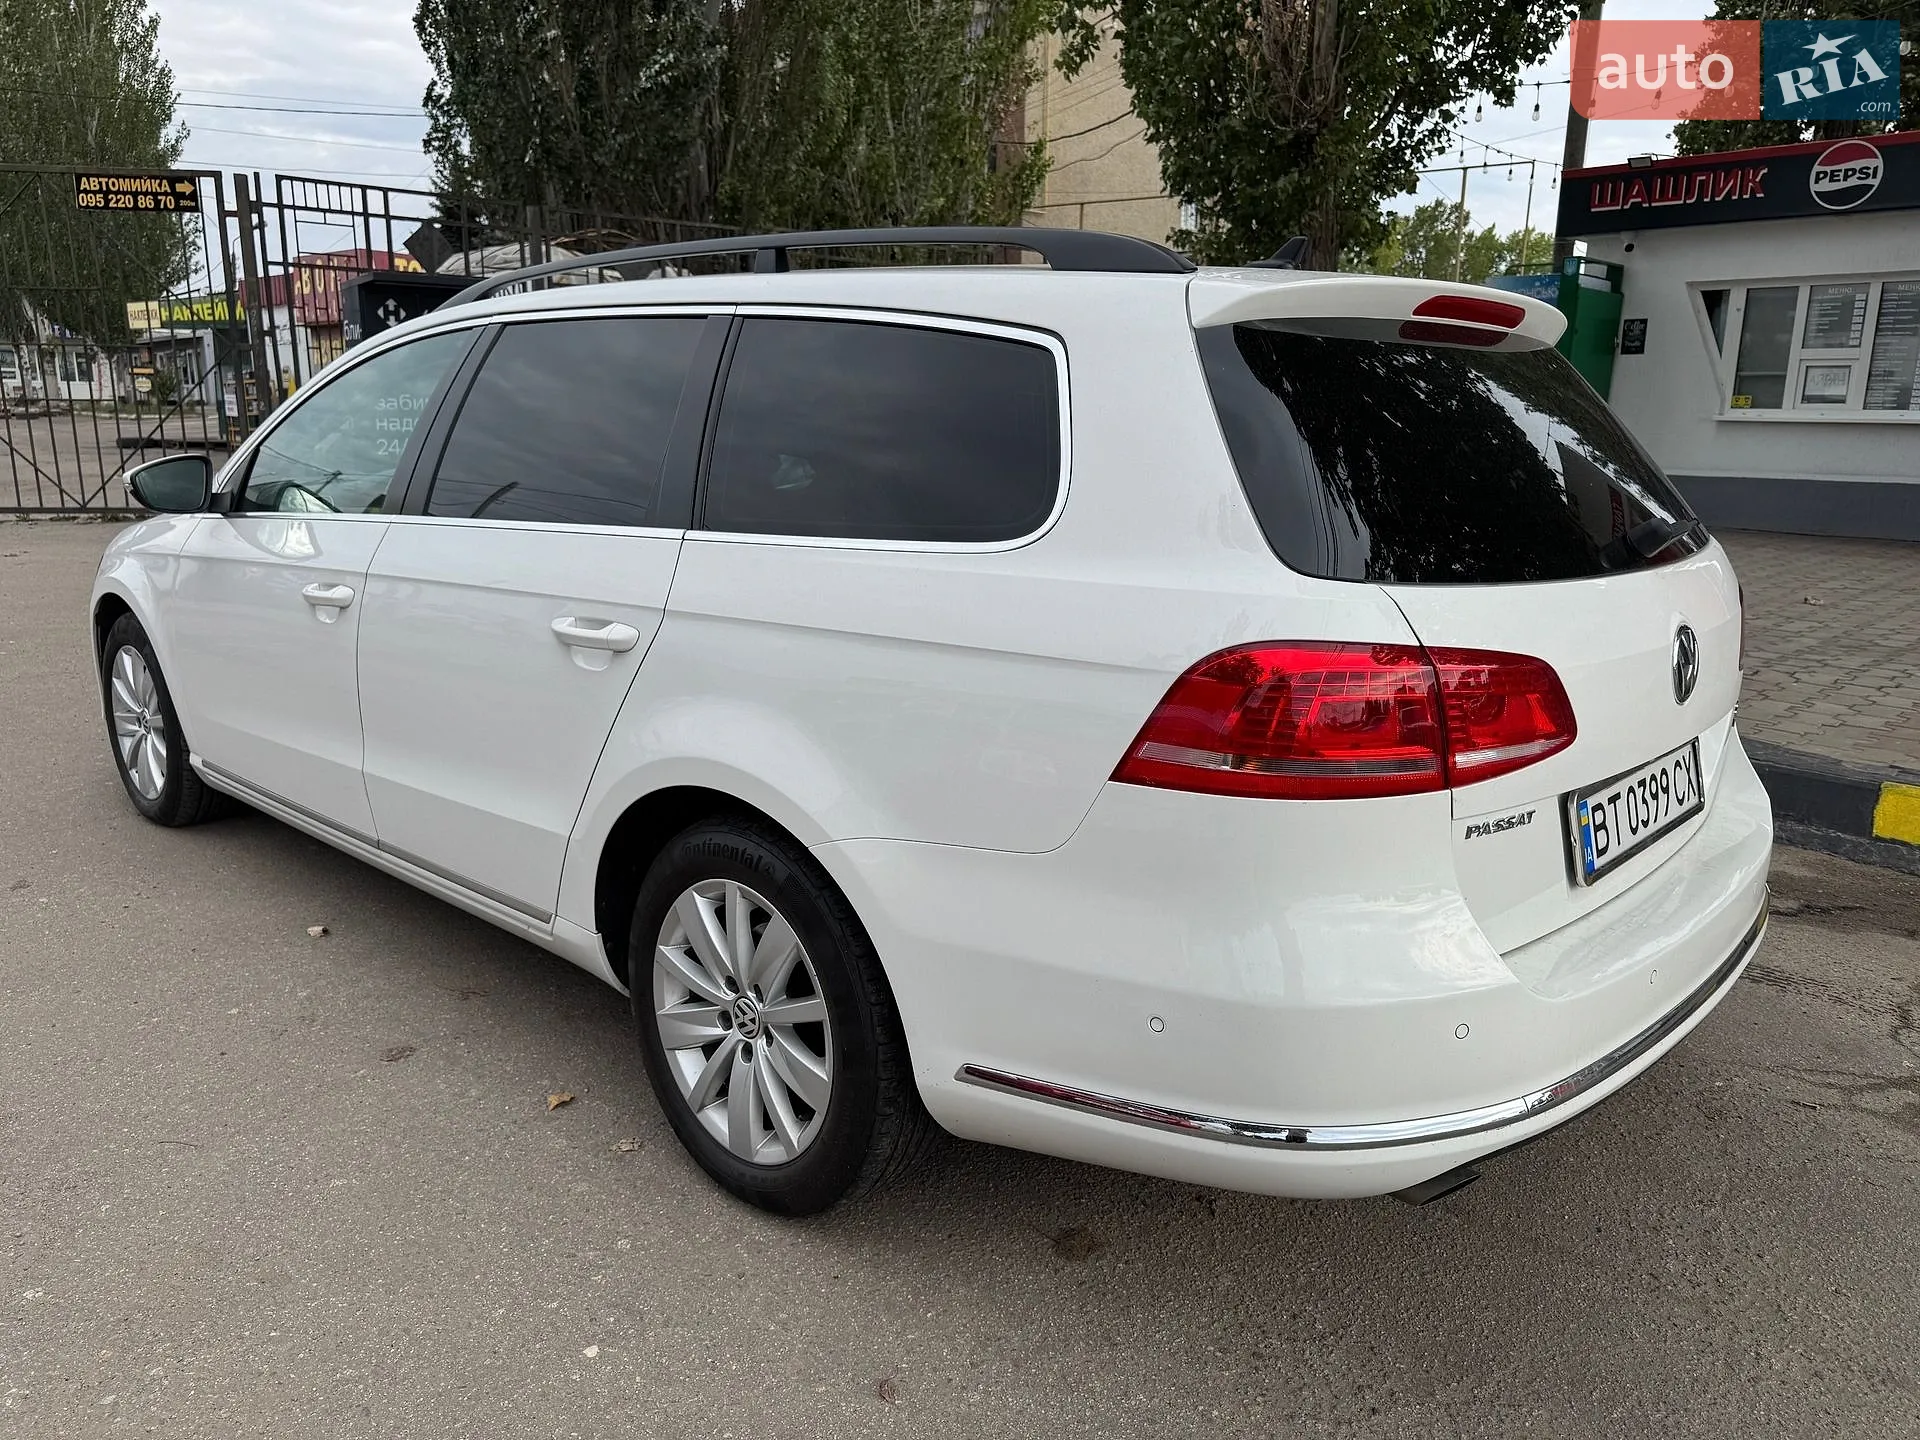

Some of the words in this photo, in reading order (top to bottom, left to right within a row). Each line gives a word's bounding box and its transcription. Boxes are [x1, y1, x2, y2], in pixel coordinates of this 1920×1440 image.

[80, 175, 171, 193] АВТОМИЙКА
[1589, 167, 1768, 213] ШАШЛИК
[1813, 164, 1880, 185] PEPSI
[78, 193, 105, 207] 095
[108, 194, 134, 208] 220
[137, 194, 155, 209] 86
[157, 195, 175, 209] 70
[1591, 791, 1622, 859] BT
[1626, 767, 1670, 836] 0399
[1673, 750, 1697, 807] CX
[1464, 809, 1536, 840] PASSAT
[680, 837, 763, 873] Continental
